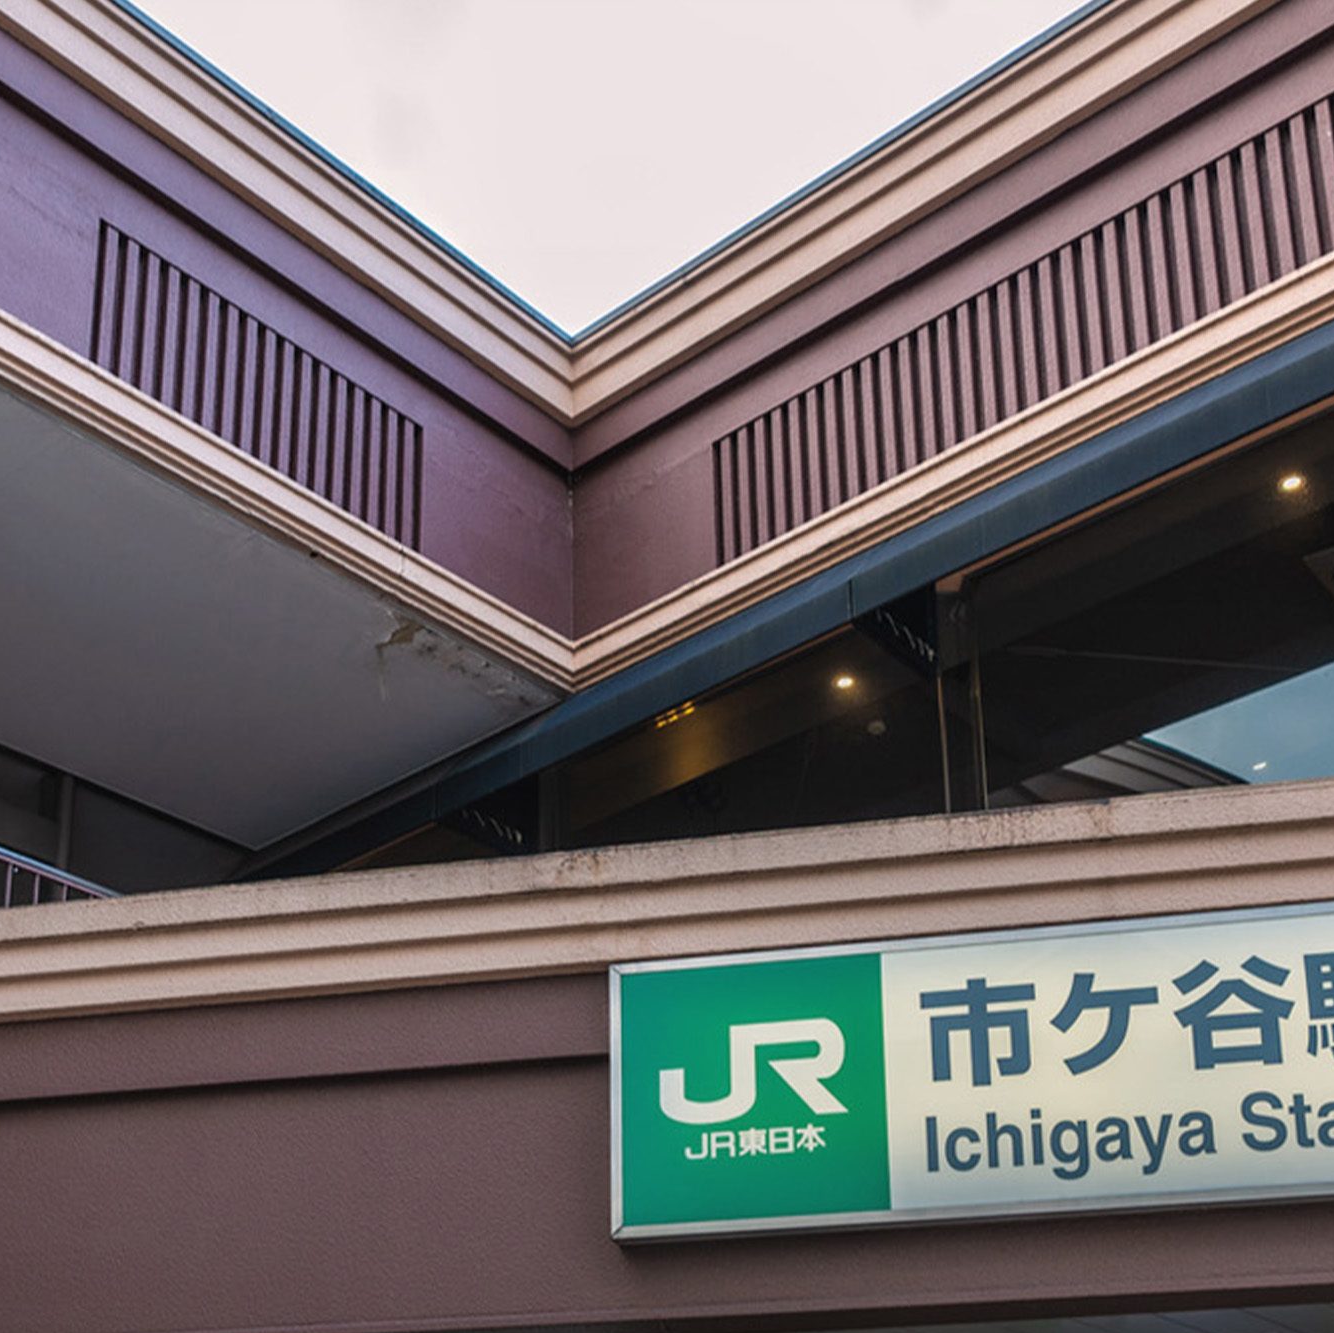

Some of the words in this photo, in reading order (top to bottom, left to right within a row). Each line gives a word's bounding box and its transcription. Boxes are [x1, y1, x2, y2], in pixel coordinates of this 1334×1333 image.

[658, 1016, 849, 1125] JR
[683, 1121, 828, 1162] JR東日本
[922, 1107, 1217, 1182] Ichigaya
